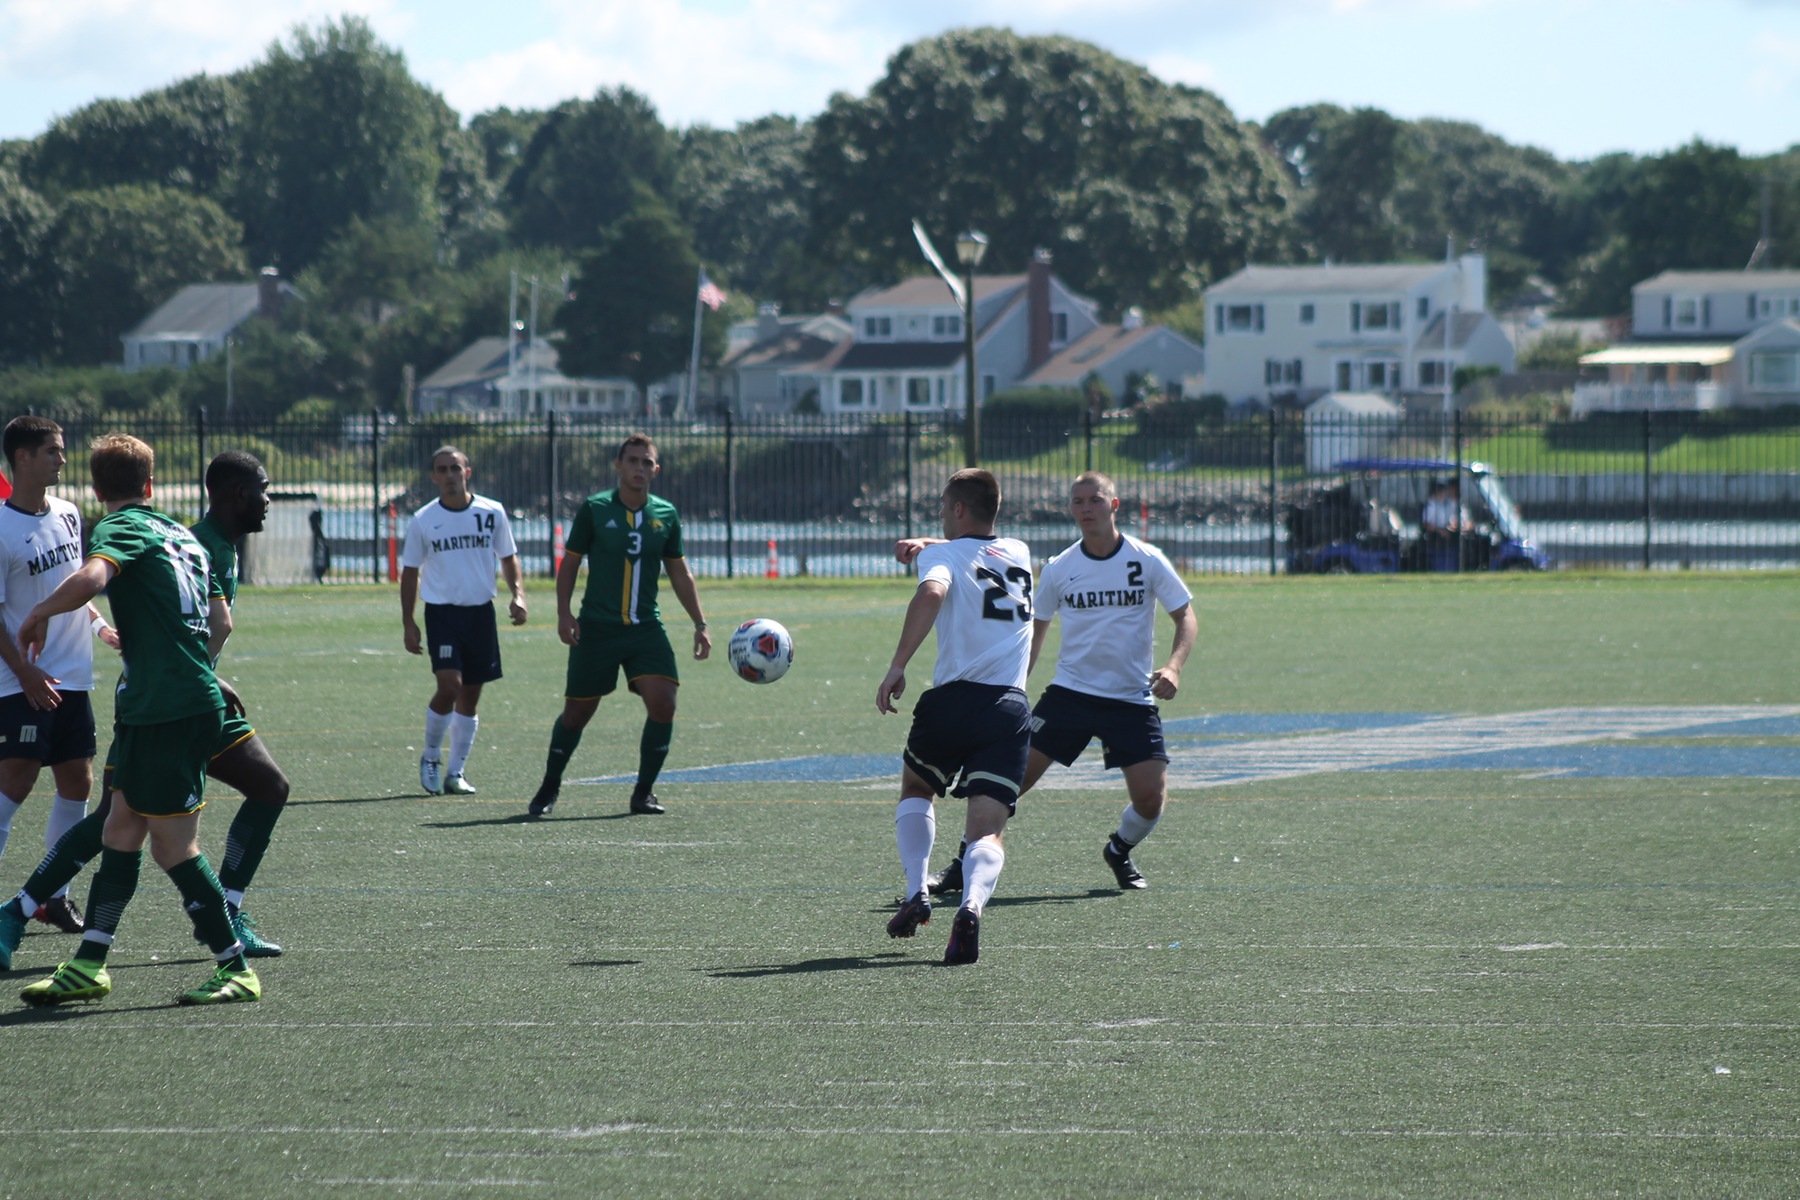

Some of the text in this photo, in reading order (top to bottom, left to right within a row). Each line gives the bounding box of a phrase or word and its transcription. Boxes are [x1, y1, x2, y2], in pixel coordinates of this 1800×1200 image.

[474, 513, 495, 534] 14
[627, 532, 642, 554] 3
[1127, 561, 1144, 587] 2
[976, 566, 1032, 622] 23
[1065, 589, 1145, 609] MARITIME
